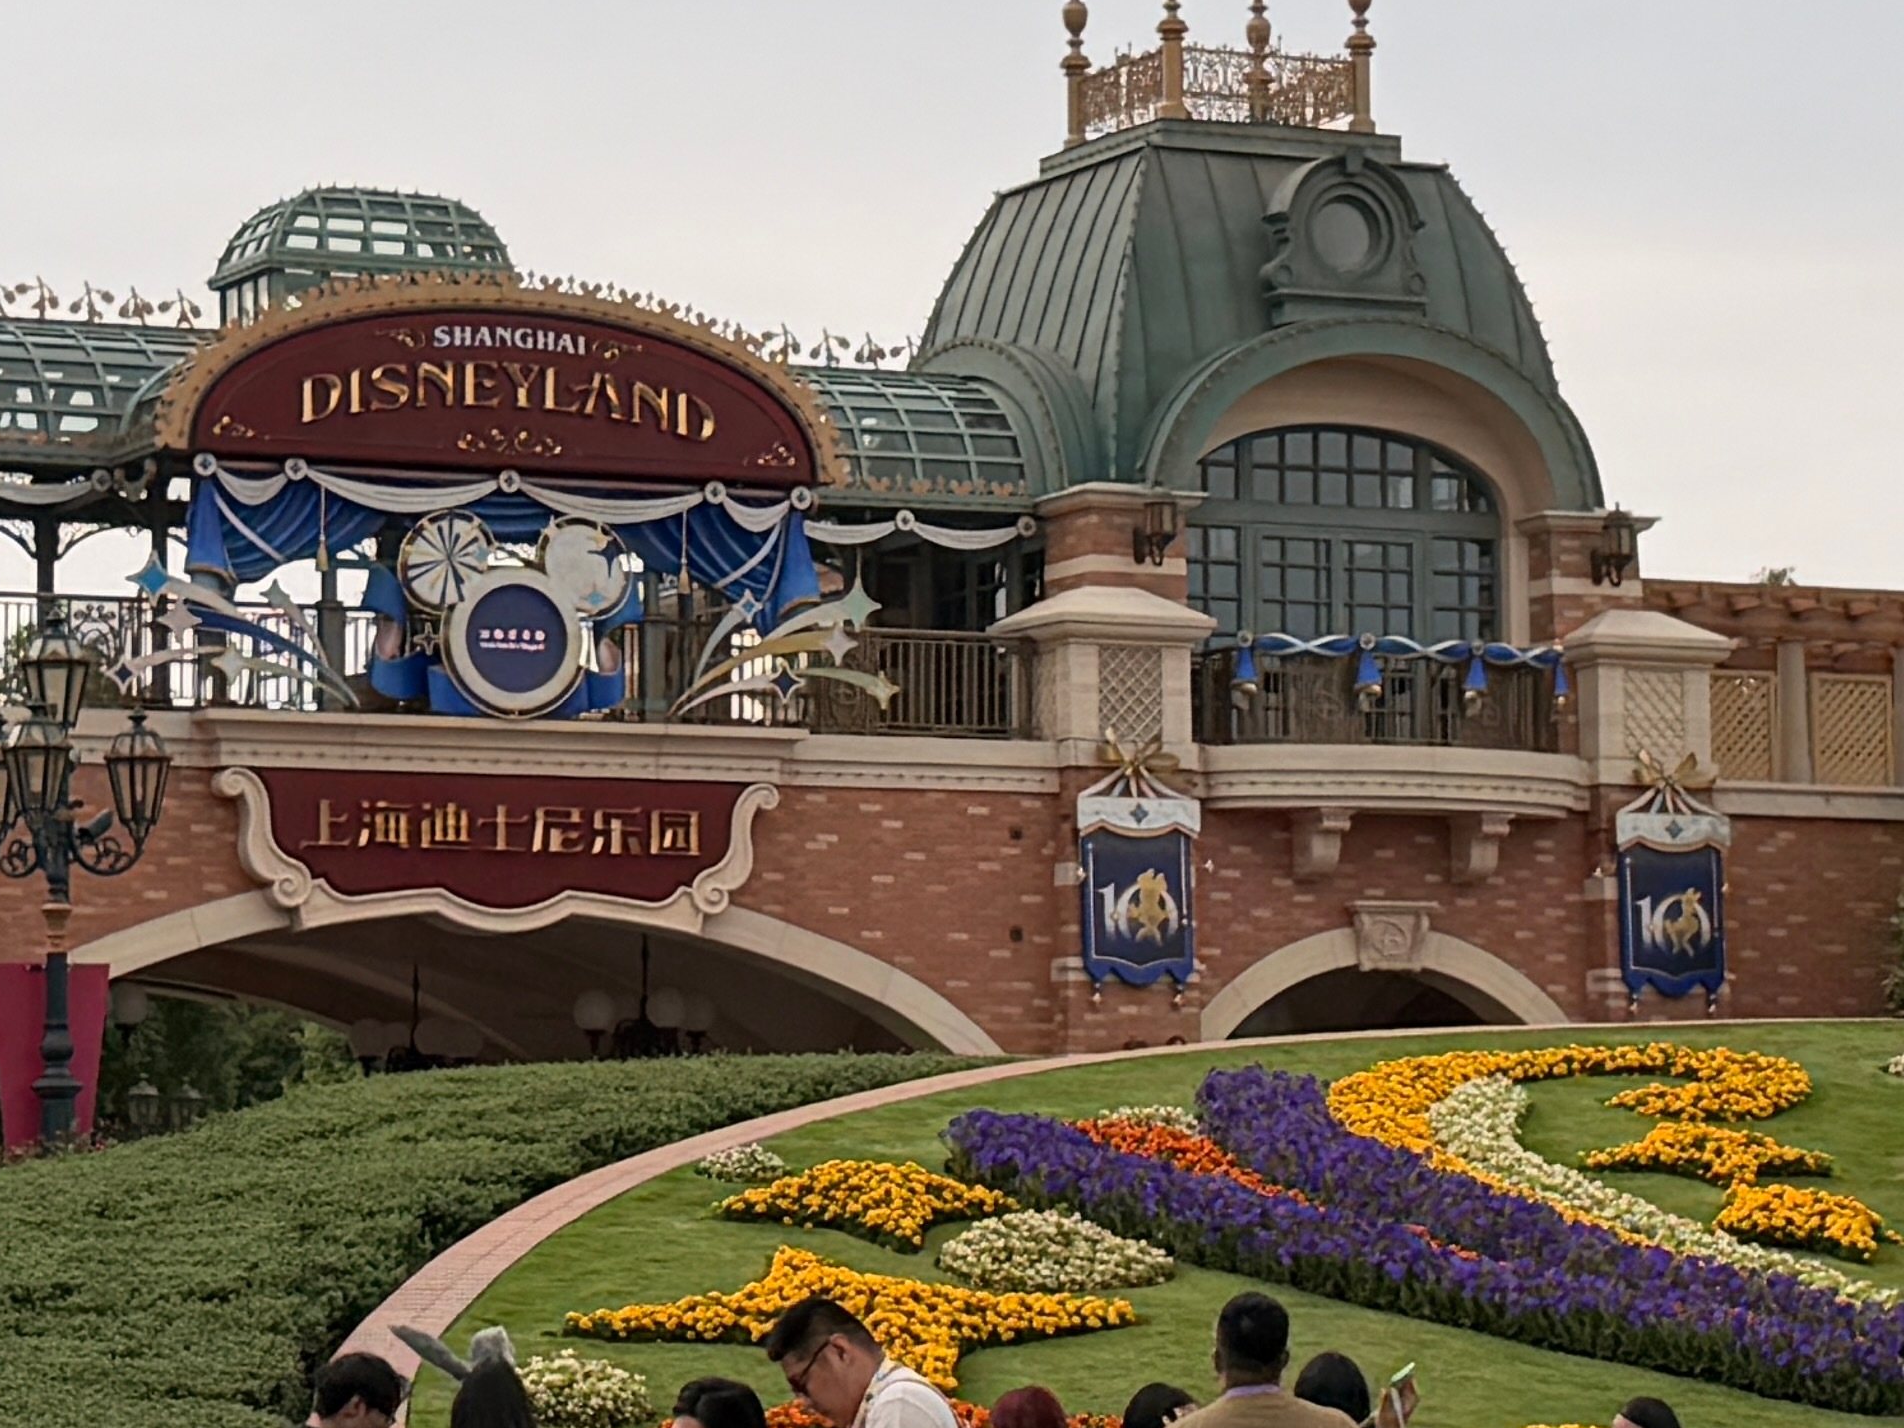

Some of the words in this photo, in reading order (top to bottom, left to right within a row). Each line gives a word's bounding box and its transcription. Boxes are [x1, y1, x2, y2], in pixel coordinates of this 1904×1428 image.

[433, 325, 586, 356] SHANGHAI
[301, 360, 717, 442] DISNEYLAND
[299, 798, 702, 857] 上海迪士尼乐园
